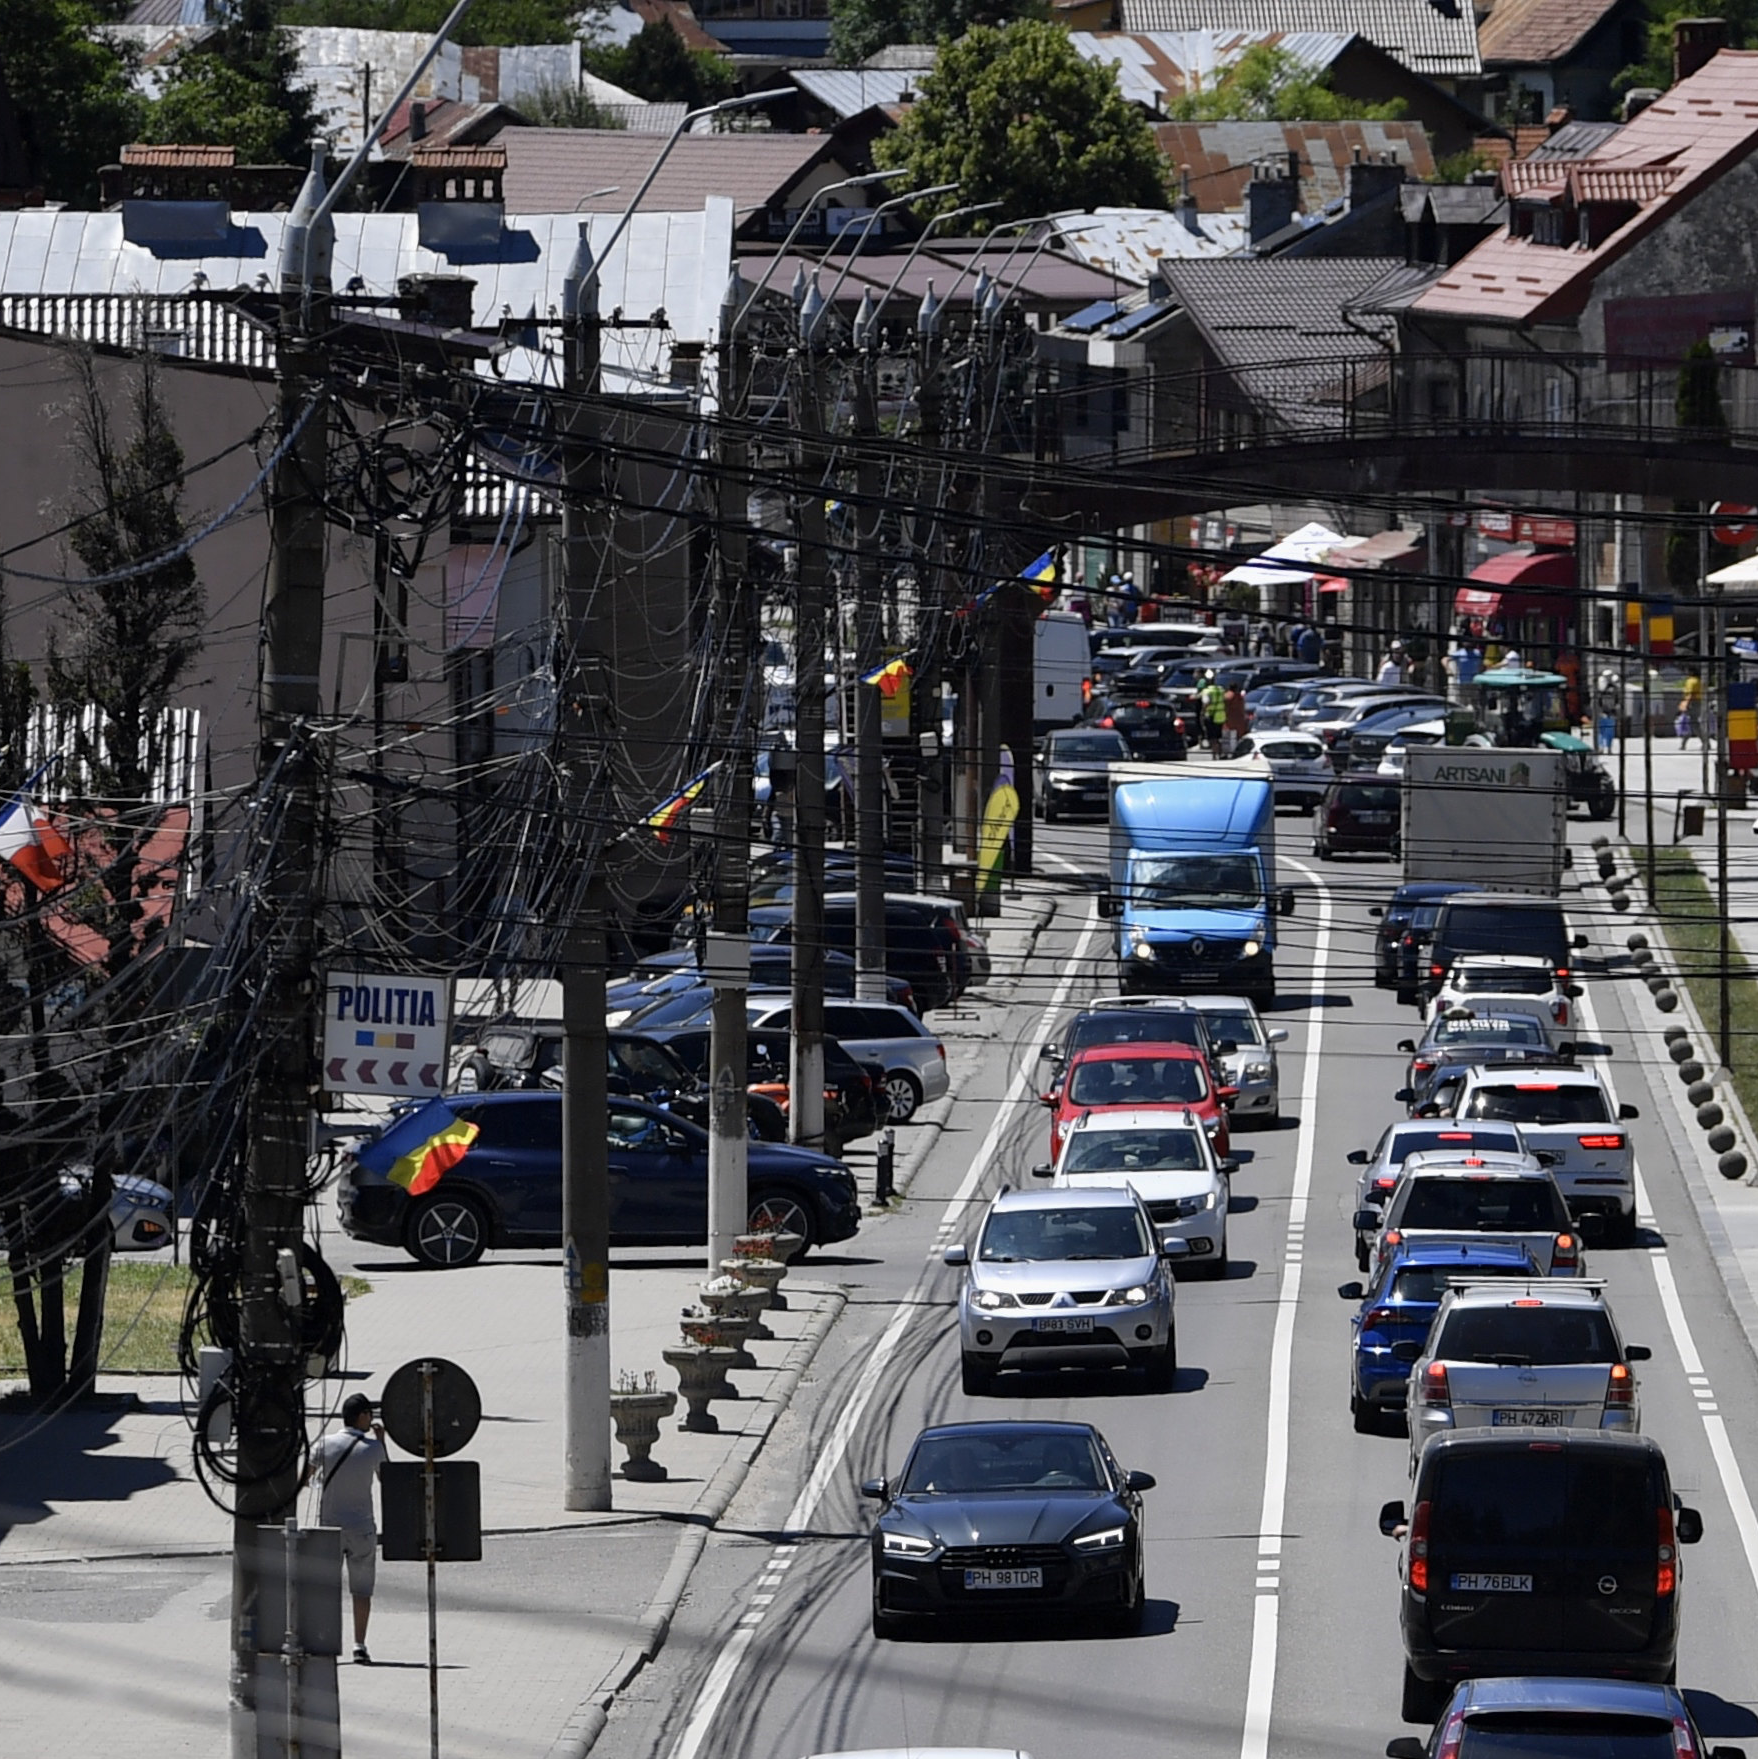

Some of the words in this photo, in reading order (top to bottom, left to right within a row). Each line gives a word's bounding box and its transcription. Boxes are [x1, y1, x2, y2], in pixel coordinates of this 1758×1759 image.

[1434, 766, 1506, 784] ARTSANI
[337, 984, 435, 1027] POLITIA
[1499, 1412, 1517, 1424] PH
[972, 1573, 991, 1585] PH
[1458, 1576, 1479, 1588] PH
